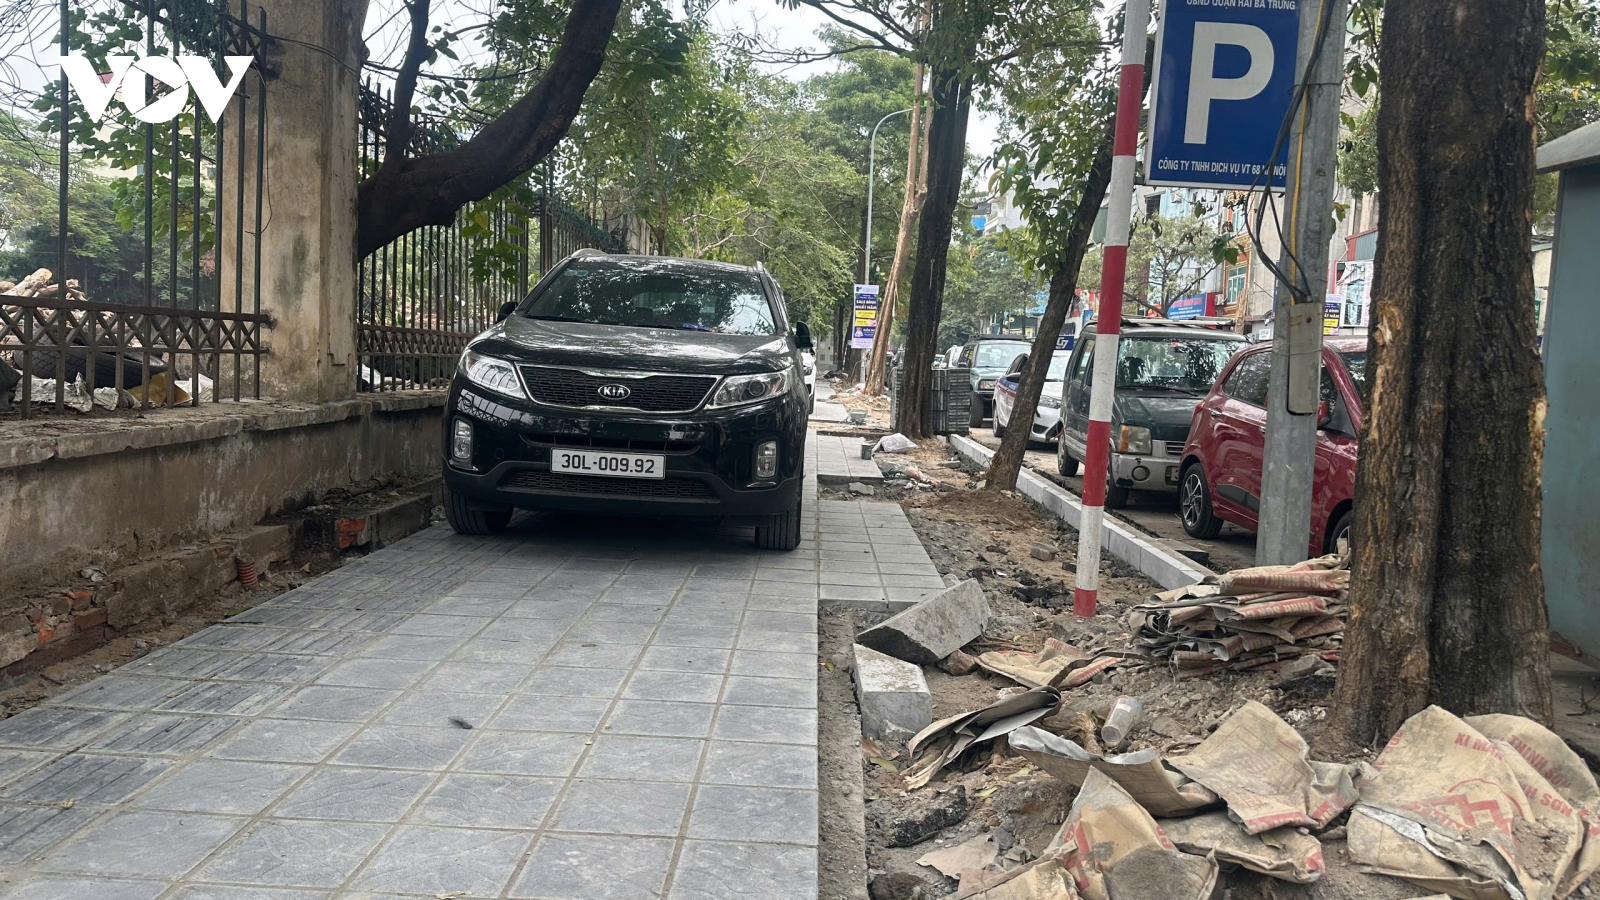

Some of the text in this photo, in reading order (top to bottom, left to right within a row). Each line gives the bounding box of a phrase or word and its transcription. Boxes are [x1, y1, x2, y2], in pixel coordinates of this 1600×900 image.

[1184, 21, 1275, 145] P
[1158, 157, 1179, 170] CÔNG
[1180, 160, 1190, 171] TY
[1191, 161, 1210, 172] TNHH
[1211, 162, 1228, 176] DỊCH
[1230, 163, 1240, 177] VỤ
[1241, 163, 1251, 174] VT
[1251, 164, 1261, 175] 68
[603, 386, 625, 397] KIA
[561, 454, 655, 474] 30L-009.92
